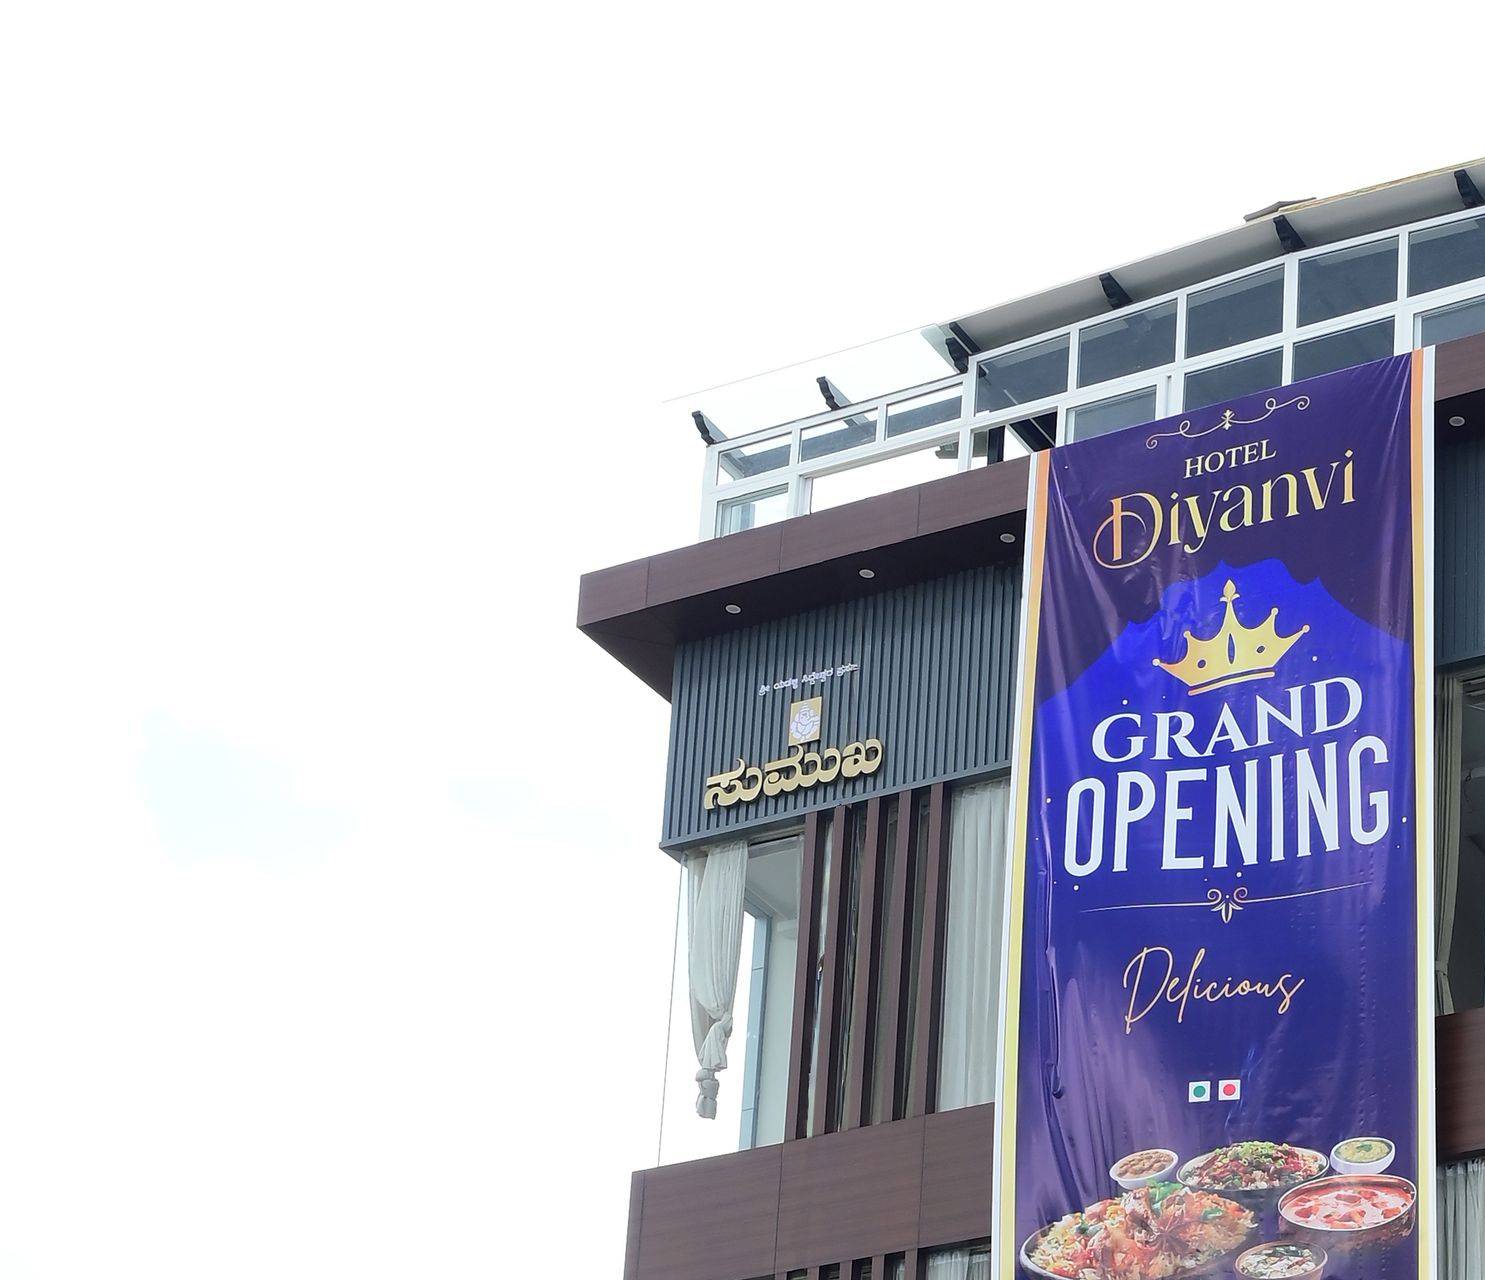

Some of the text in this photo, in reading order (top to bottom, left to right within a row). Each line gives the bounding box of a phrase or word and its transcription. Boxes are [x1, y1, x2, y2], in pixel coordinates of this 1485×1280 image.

[1183, 439, 1277, 479] HOTEL
[1093, 449, 1356, 568] Diyanvi
[1091, 676, 1363, 763] GRAND
[704, 738, 883, 810] ಸುಮುಖ
[1063, 735, 1390, 876] OPENING
[1122, 945, 1305, 1034] Delicious
